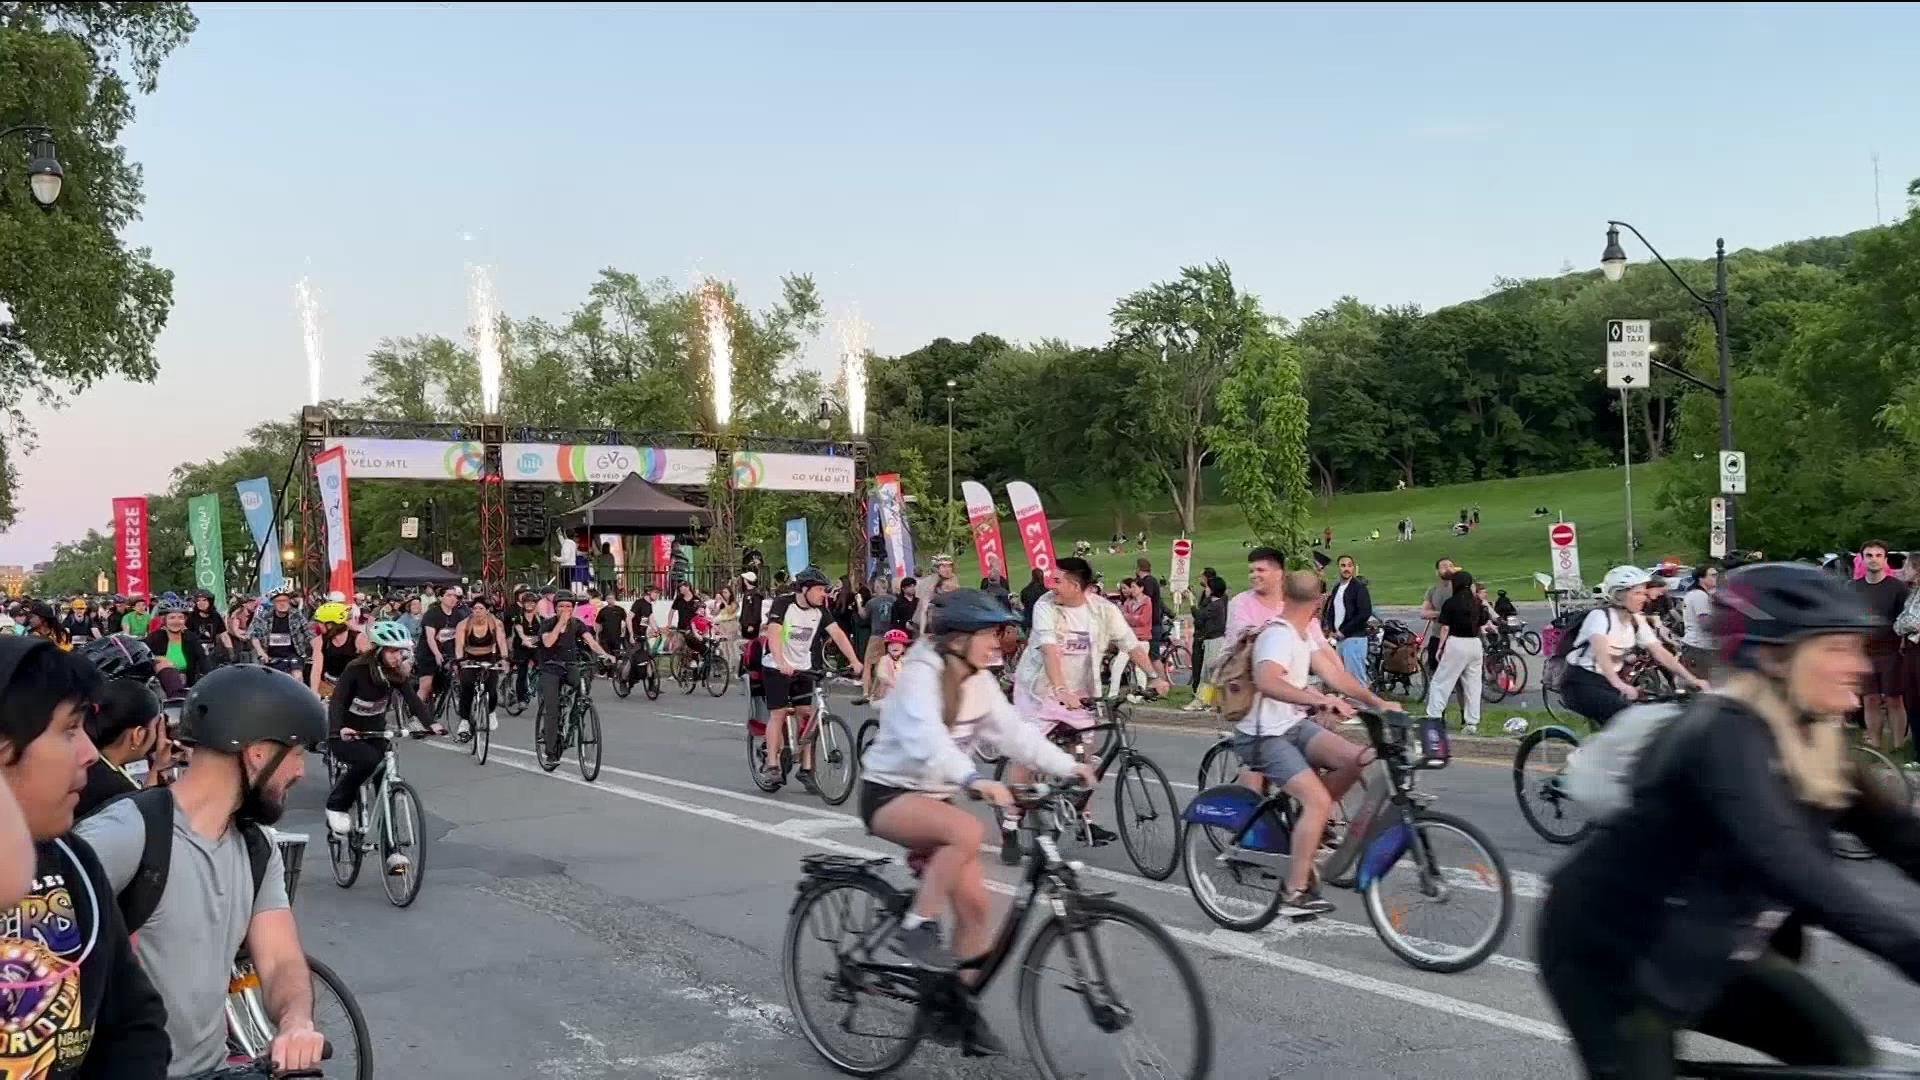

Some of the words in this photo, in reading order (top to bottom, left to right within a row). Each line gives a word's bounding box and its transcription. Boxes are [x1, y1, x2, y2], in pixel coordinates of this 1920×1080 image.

[1626, 325, 1643, 333] BUS
[386, 459, 408, 468] MTL
[792, 473, 806, 481] GO
